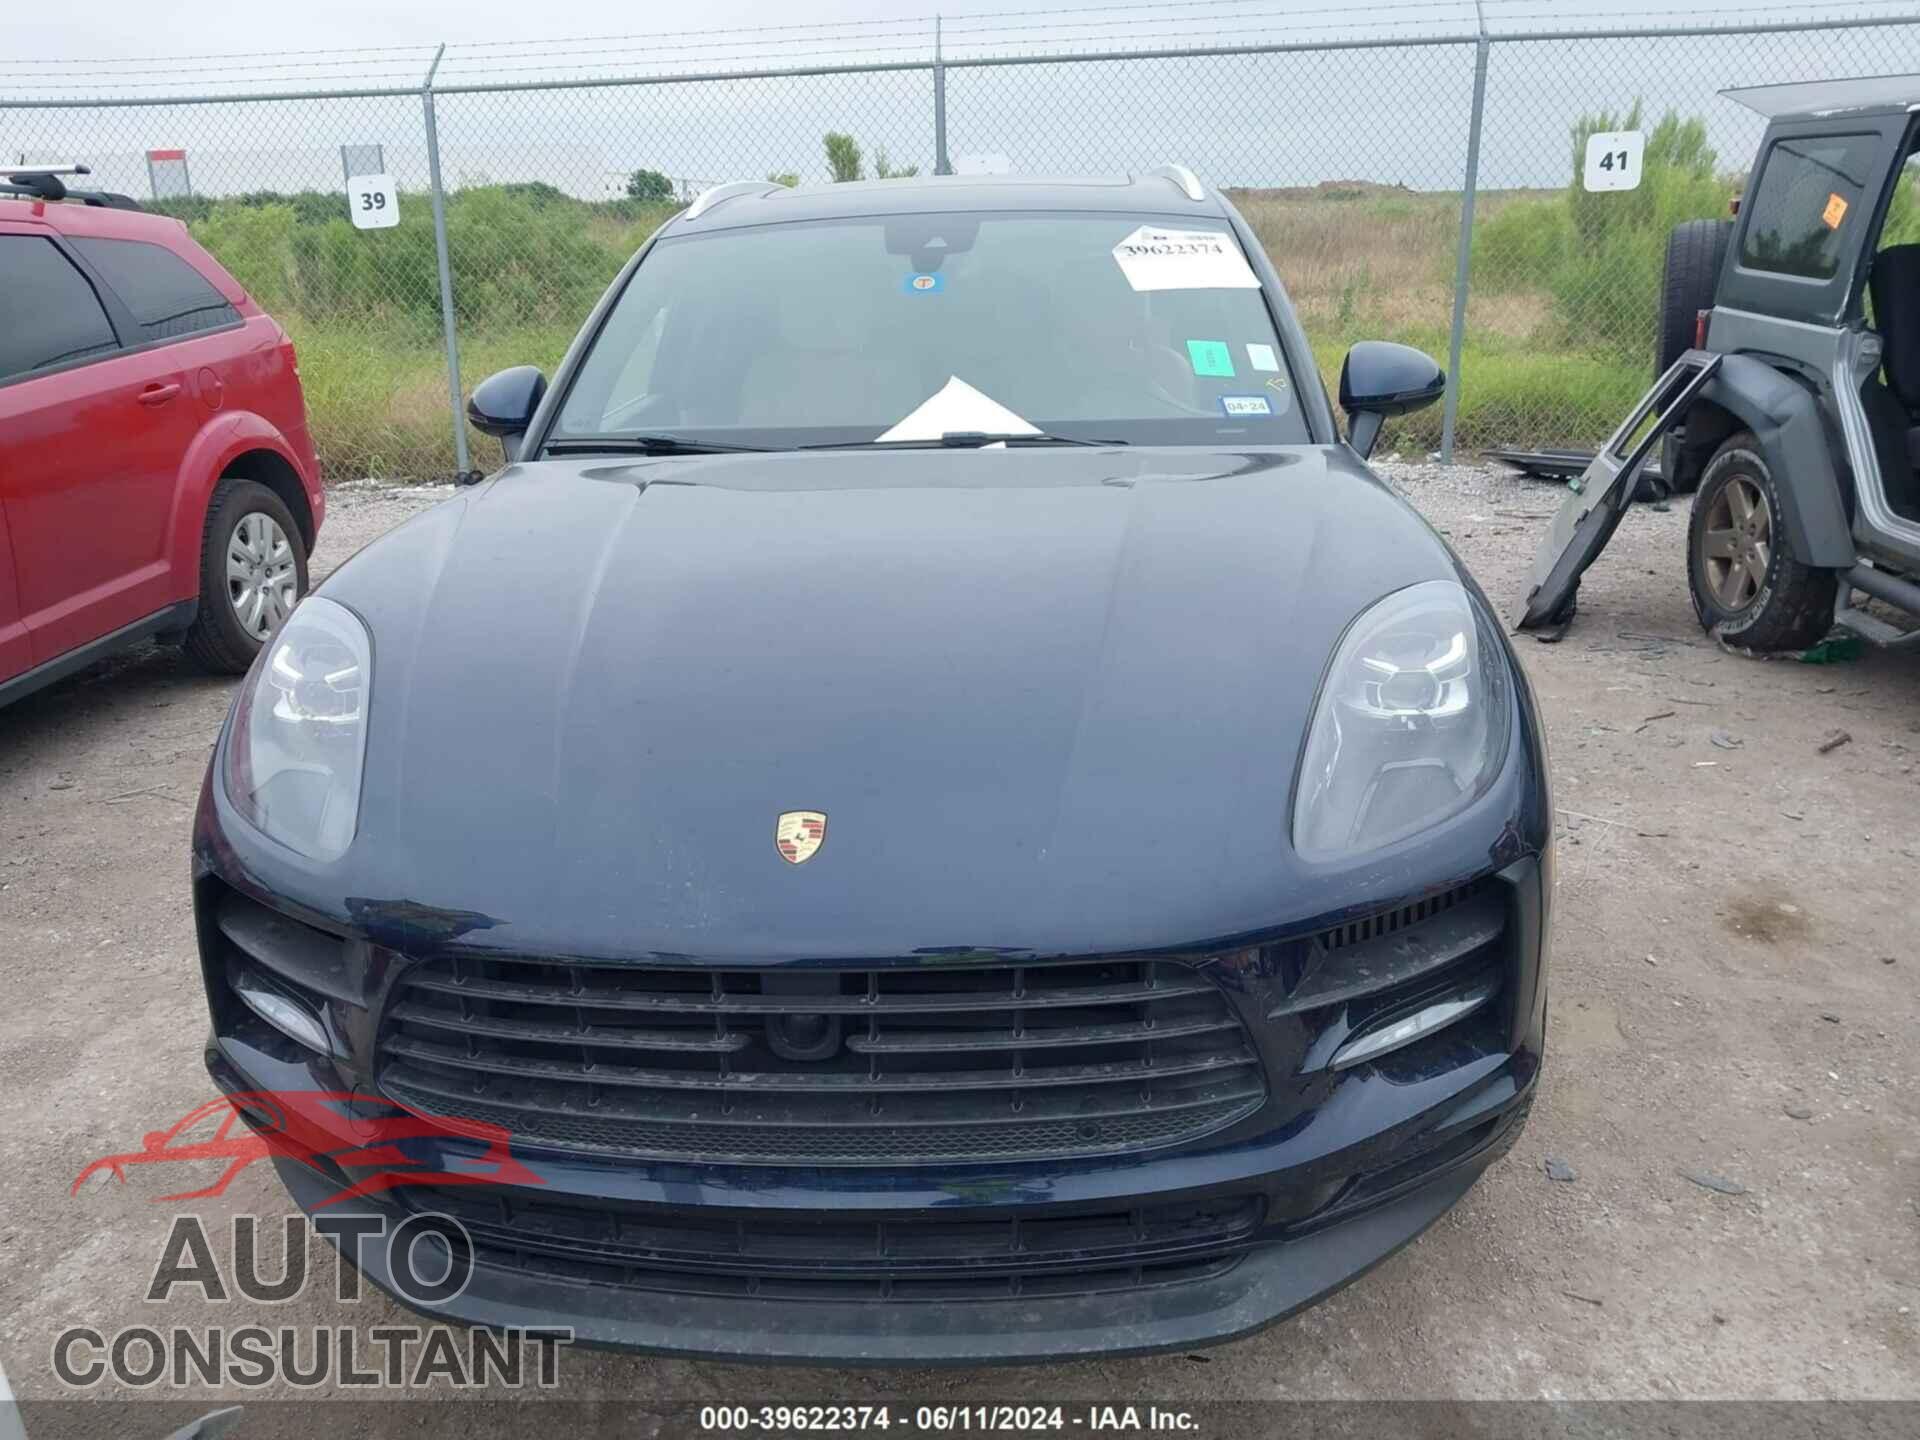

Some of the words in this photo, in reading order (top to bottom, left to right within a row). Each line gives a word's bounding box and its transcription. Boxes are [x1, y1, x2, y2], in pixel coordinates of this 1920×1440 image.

[1599, 150, 1628, 171] 41
[361, 191, 386, 211] 39
[1122, 243, 1223, 256] 39622374
[1227, 402, 1266, 411] 04-24
